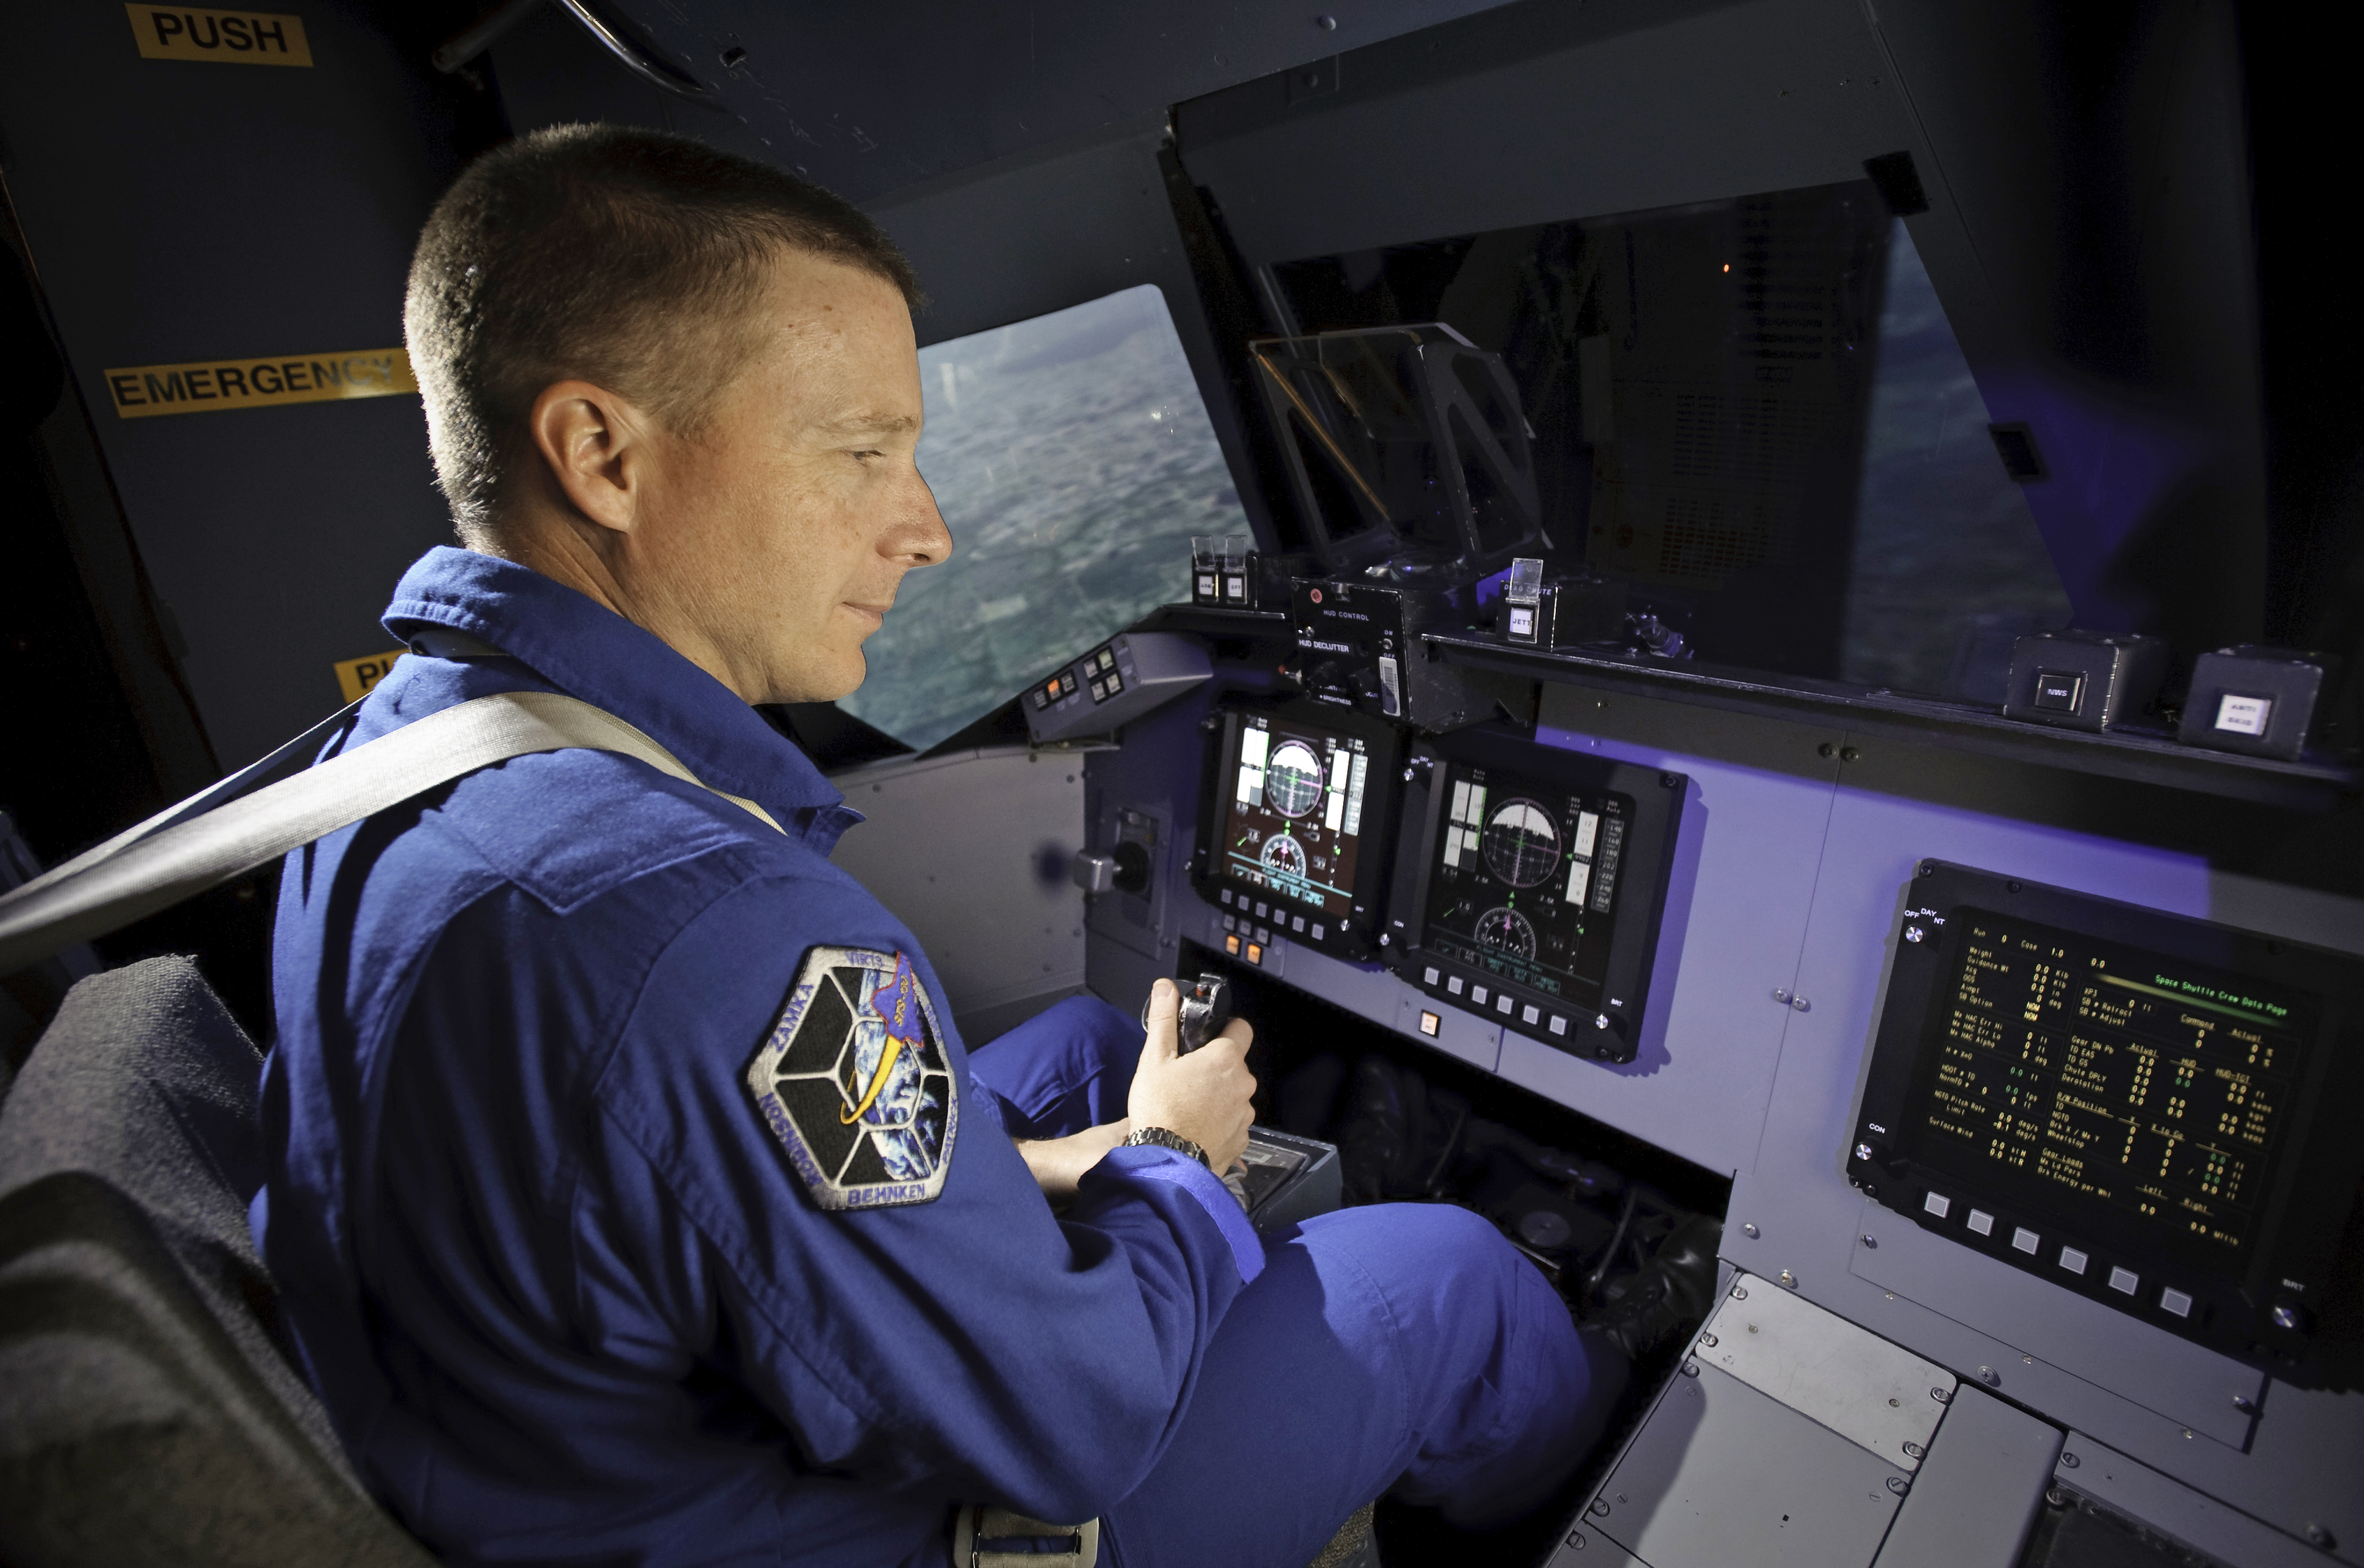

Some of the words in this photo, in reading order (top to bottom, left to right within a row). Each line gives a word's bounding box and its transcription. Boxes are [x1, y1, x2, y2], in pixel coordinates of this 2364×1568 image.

[152, 12, 288, 53] PUSH
[111, 356, 393, 406] EMERGENCY
[1527, 587, 1552, 595] CHUTE
[1339, 611, 1369, 621] CONTROL
[1299, 639, 1312, 647] HUD
[1313, 642, 1349, 653] DECLUTTER
[1323, 695, 1351, 705] BRIGHTNESS
[1904, 910, 1920, 918] OFF
[1920, 908, 1937, 917] DAY
[1974, 928, 1986, 937] Run
[2002, 935, 2007, 943] 0
[2021, 940, 2037, 951] Case
[1970, 946, 1992, 958] Weight
[1967, 955, 1998, 970] Guidance
[2036, 994, 2043, 1003] 0
[2156, 974, 2178, 988] Space
[2182, 981, 2215, 998] Shuttle
[2218, 991, 2238, 1003] Crew
[2242, 997, 2263, 1010] Data
[2266, 1003, 2288, 1017] Page
[1611, 998, 1623, 1008] BRT
[1970, 995, 1993, 1008] Option
[2128, 999, 2135, 1009] 0
[2102, 1002, 2132, 1017] Retract
[769, 985, 813, 1052] ZAMKA
[2099, 1012, 2125, 1027] Adjust
[2180, 1013, 2215, 1030] Command
[2027, 1032, 2033, 1041] 0
[2198, 1030, 2205, 1039] 0
[2025, 1041, 2031, 1049] 0
[2072, 1035, 2088, 1046] Gear
[2196, 1039, 2202, 1049] 0
[1976, 1036, 1995, 1049] Alpha
[2023, 1050, 2029, 1059] 0
[2251, 1044, 2258, 1053] 0
[2081, 1049, 2095, 1060] EAS
[2248, 1054, 2255, 1064] 0
[2064, 1064, 2086, 1076] Chute
[2061, 1073, 2104, 1093] Derotation
[1981, 1086, 1987, 1095] 0
[2011, 1097, 2017, 1105] 0
[1947, 1104, 1965, 1116] Limit
[1951, 1096, 1969, 1107] Pitch
[1970, 1101, 1986, 1114] Rate
[2073, 1097, 2107, 1114] Position
[1869, 1123, 1885, 1134] CON
[1929, 1116, 1955, 1131] Surface
[1957, 1127, 1973, 1138] Wind
[2130, 1126, 2136, 1134] 0
[2127, 1136, 2133, 1144] 0
[2168, 1138, 2175, 1148] 0
[2124, 1145, 2131, 1154] 0
[2165, 1148, 2172, 1157] 0
[2043, 1147, 2058, 1158] Gear
[2062, 1153, 2083, 1168] Loads
[2122, 1155, 2128, 1164] 0
[2163, 1158, 2169, 1167] 0
[2160, 1168, 2166, 1177] 0
[2053, 1171, 2079, 1187] Energy
[2081, 1184, 2094, 1193] per
[848, 1183, 925, 1205] BEHNKEN
[2283, 1278, 2305, 1292] BRT
